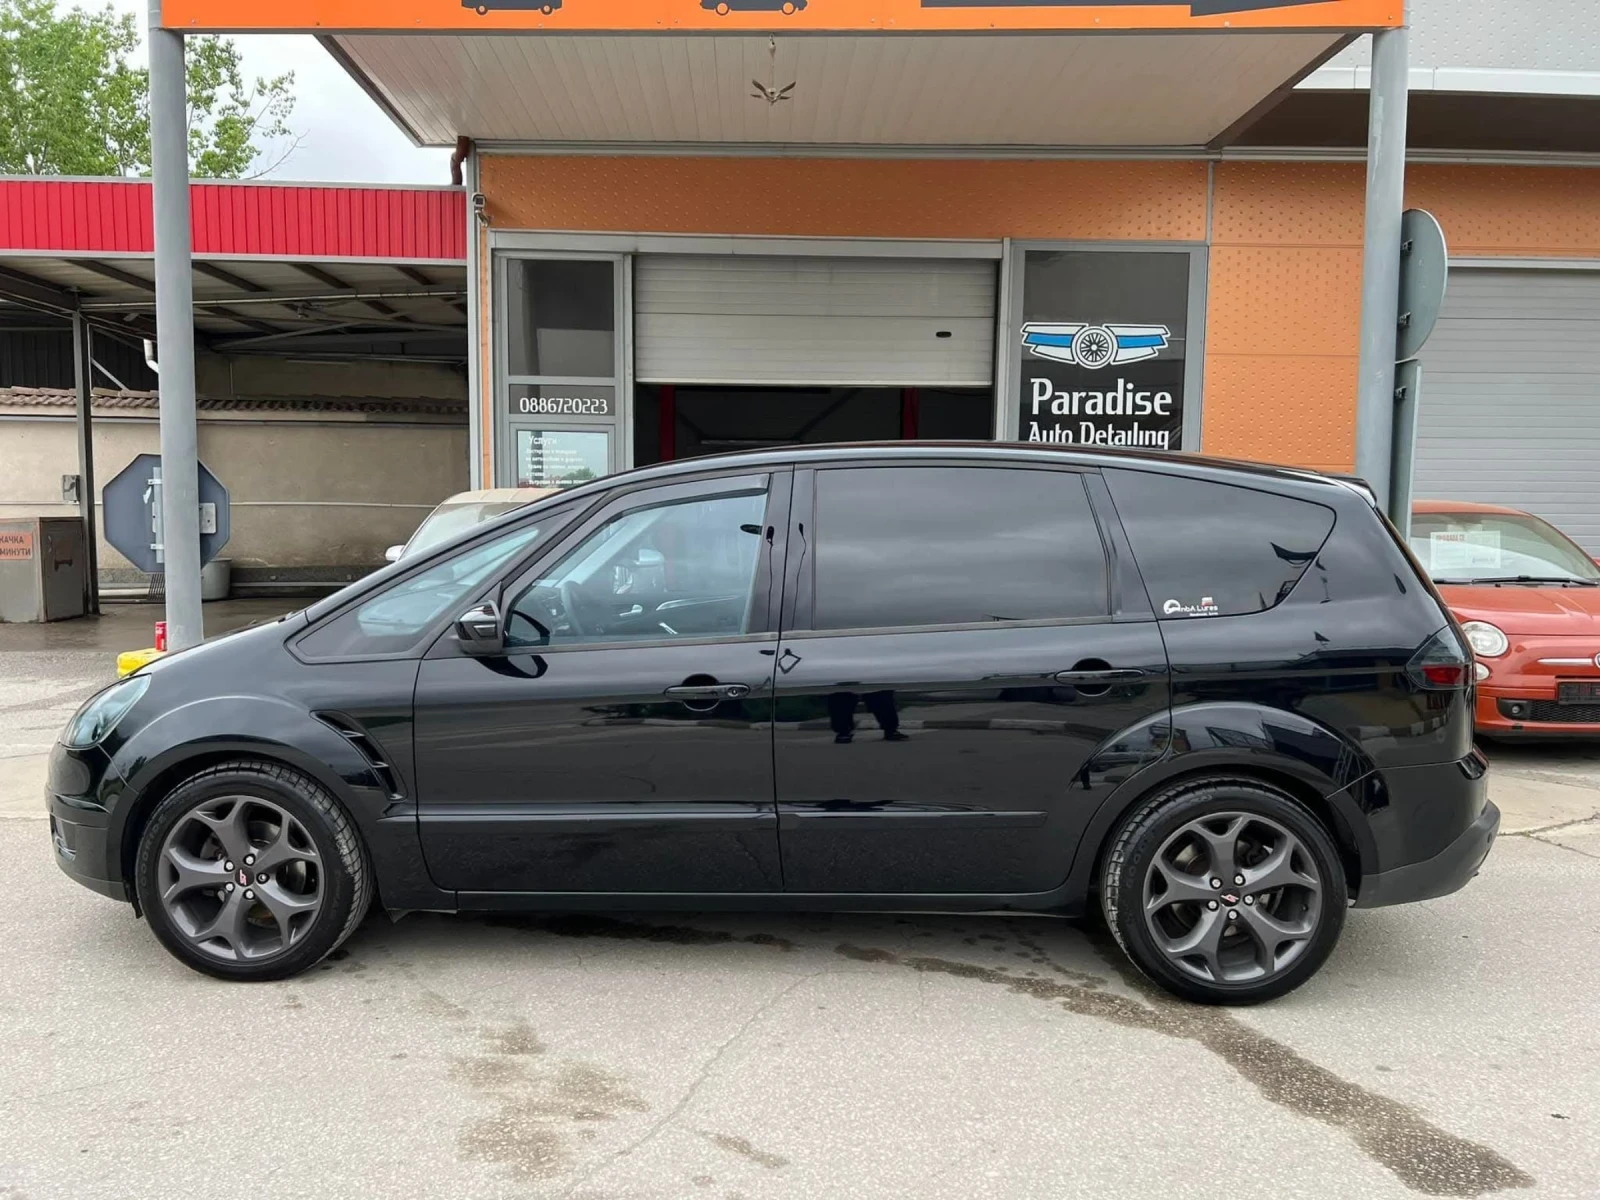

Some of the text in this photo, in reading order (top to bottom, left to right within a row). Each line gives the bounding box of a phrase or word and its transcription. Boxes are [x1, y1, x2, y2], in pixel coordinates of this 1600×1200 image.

[519, 397, 608, 414] 0886720223
[1030, 378, 1172, 415] Paradise
[1028, 422, 1170, 450] Auto Detailing
